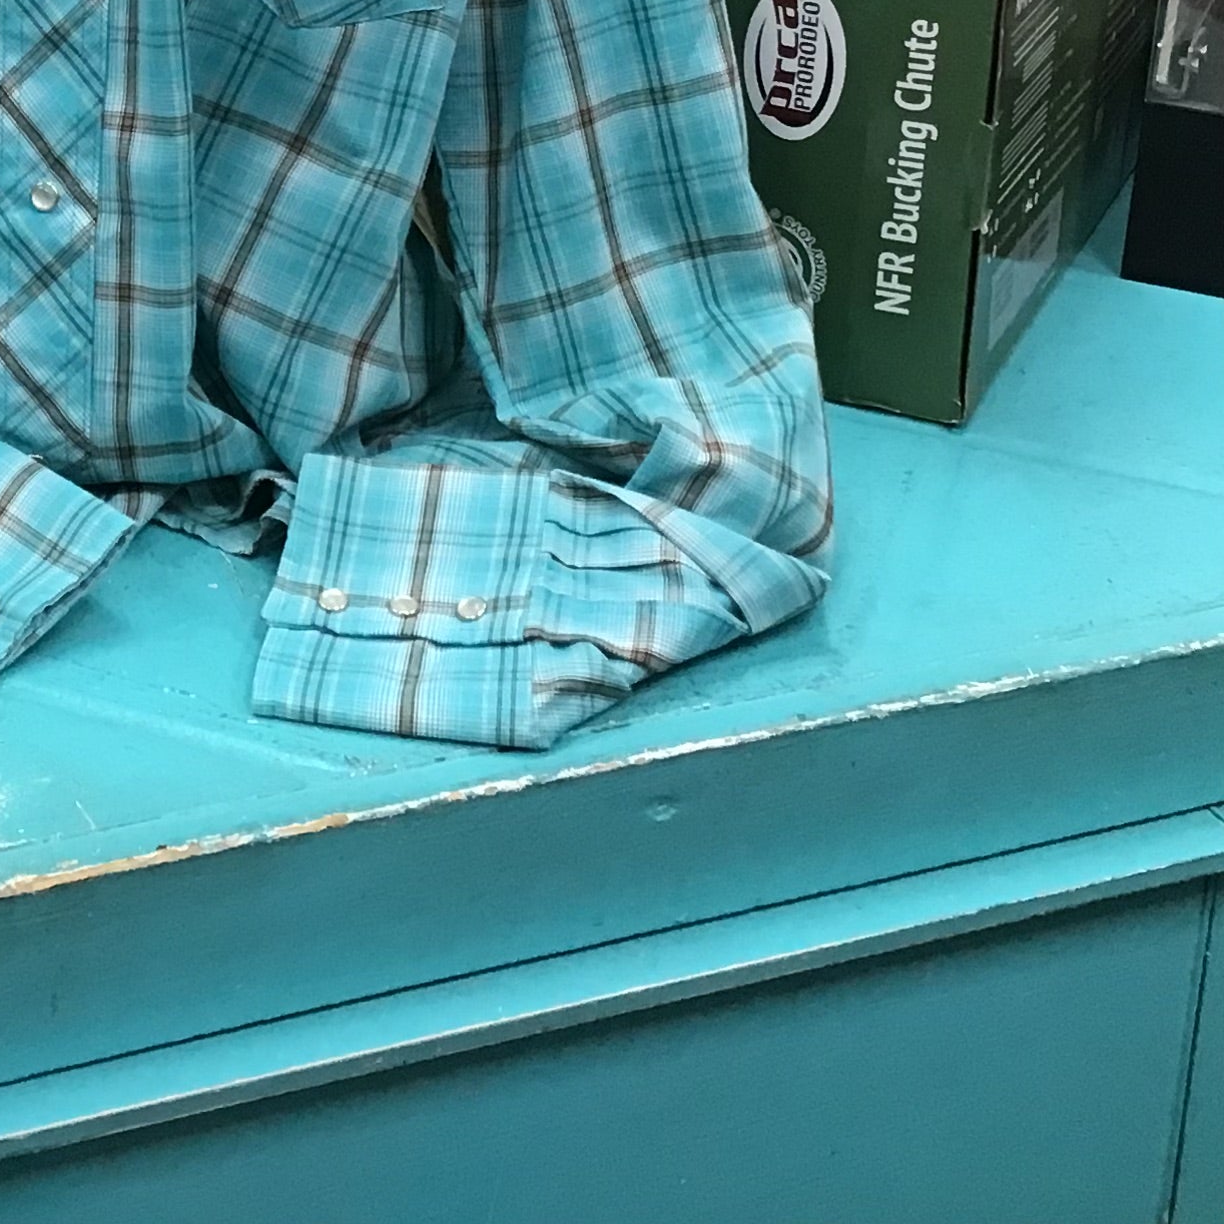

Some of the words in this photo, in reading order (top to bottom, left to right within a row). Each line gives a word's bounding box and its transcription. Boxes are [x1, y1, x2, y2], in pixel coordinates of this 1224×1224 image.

[793, 0, 821, 111] PRORODEO
[893, 18, 940, 112] Chute
[880, 119, 939, 245] Bucking
[782, 216, 816, 246] TOYS
[874, 251, 916, 316] NFR
